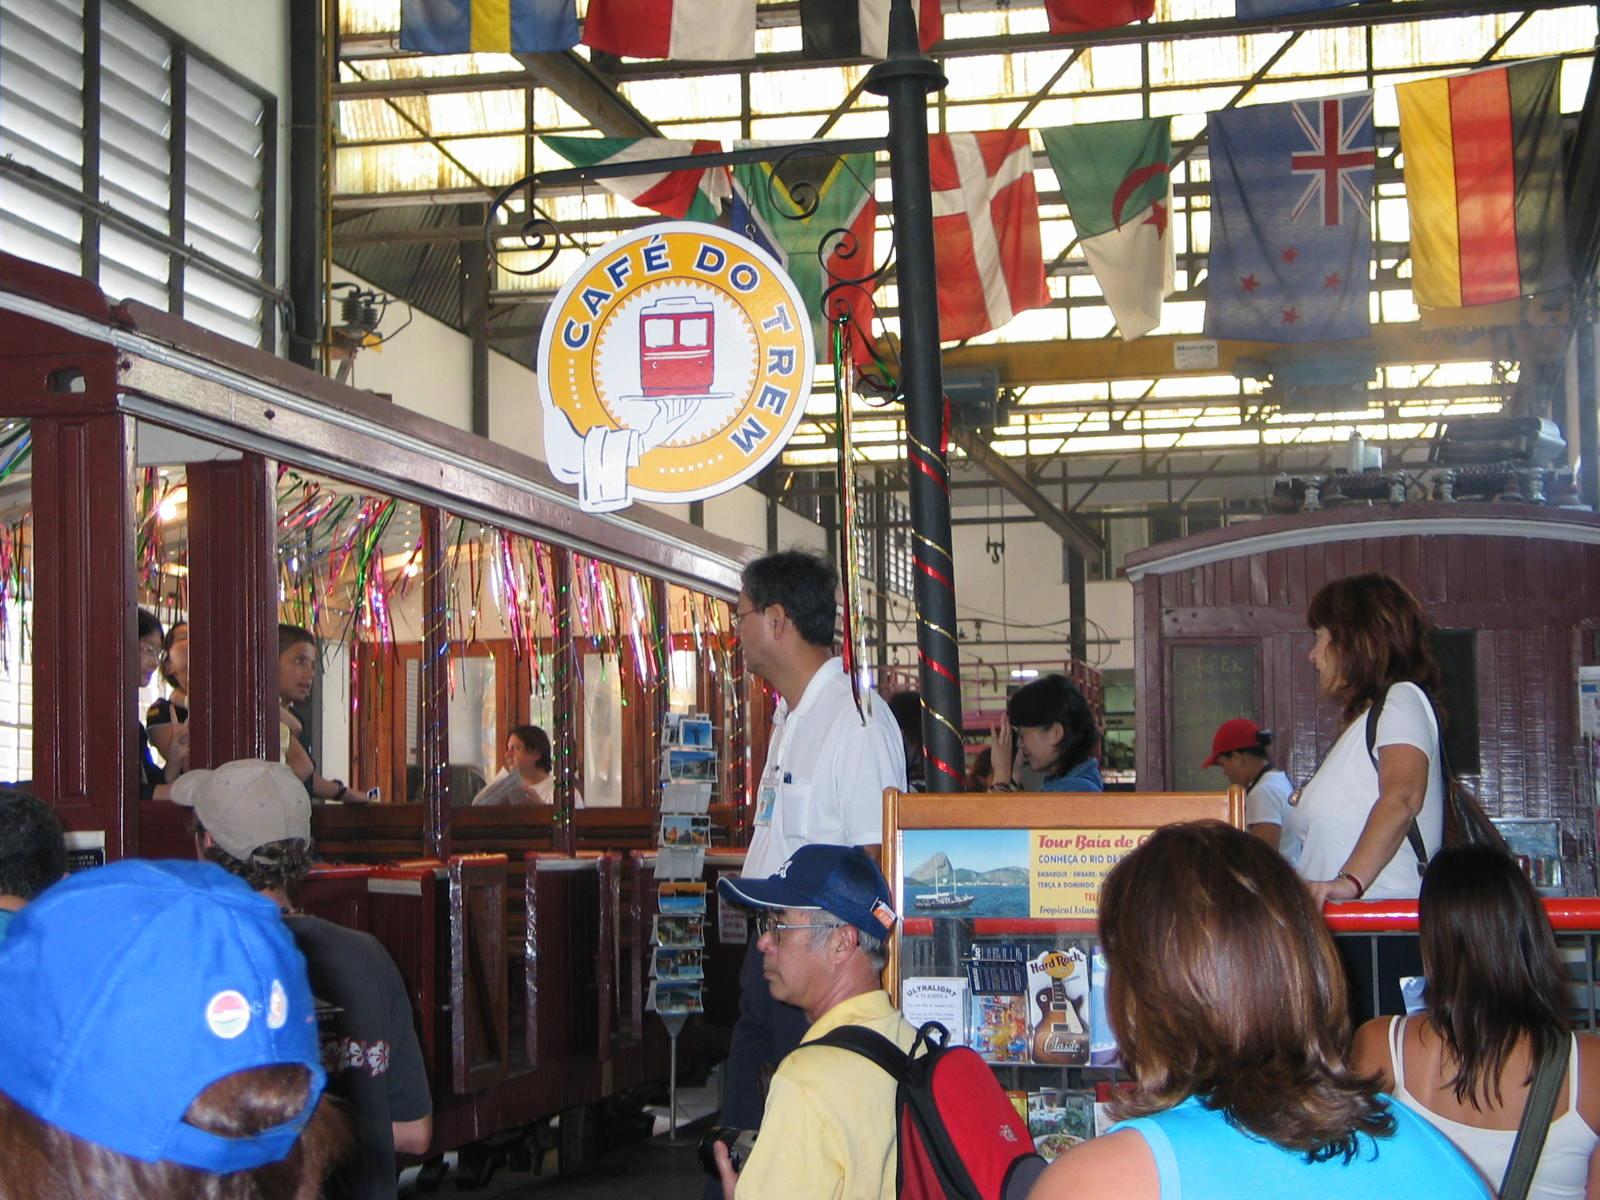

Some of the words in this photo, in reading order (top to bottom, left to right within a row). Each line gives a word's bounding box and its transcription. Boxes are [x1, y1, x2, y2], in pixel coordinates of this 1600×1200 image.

[563, 235, 670, 348] CAFÉ
[695, 245, 758, 291] DO
[731, 305, 794, 453] TREM
[1038, 835, 1072, 848] Tour
[1115, 835, 1133, 848] de
[1039, 855, 1078, 867] CONHEÇA
[1081, 855, 1087, 863] O
[1090, 855, 1104, 863] RIO
[1038, 882, 1056, 890] TERÇA
[1040, 906, 1072, 917] Tropical
[1030, 961, 1055, 974] Hard
[1056, 951, 1083, 967] Rock
[907, 984, 957, 997] ULTRALIGHT
